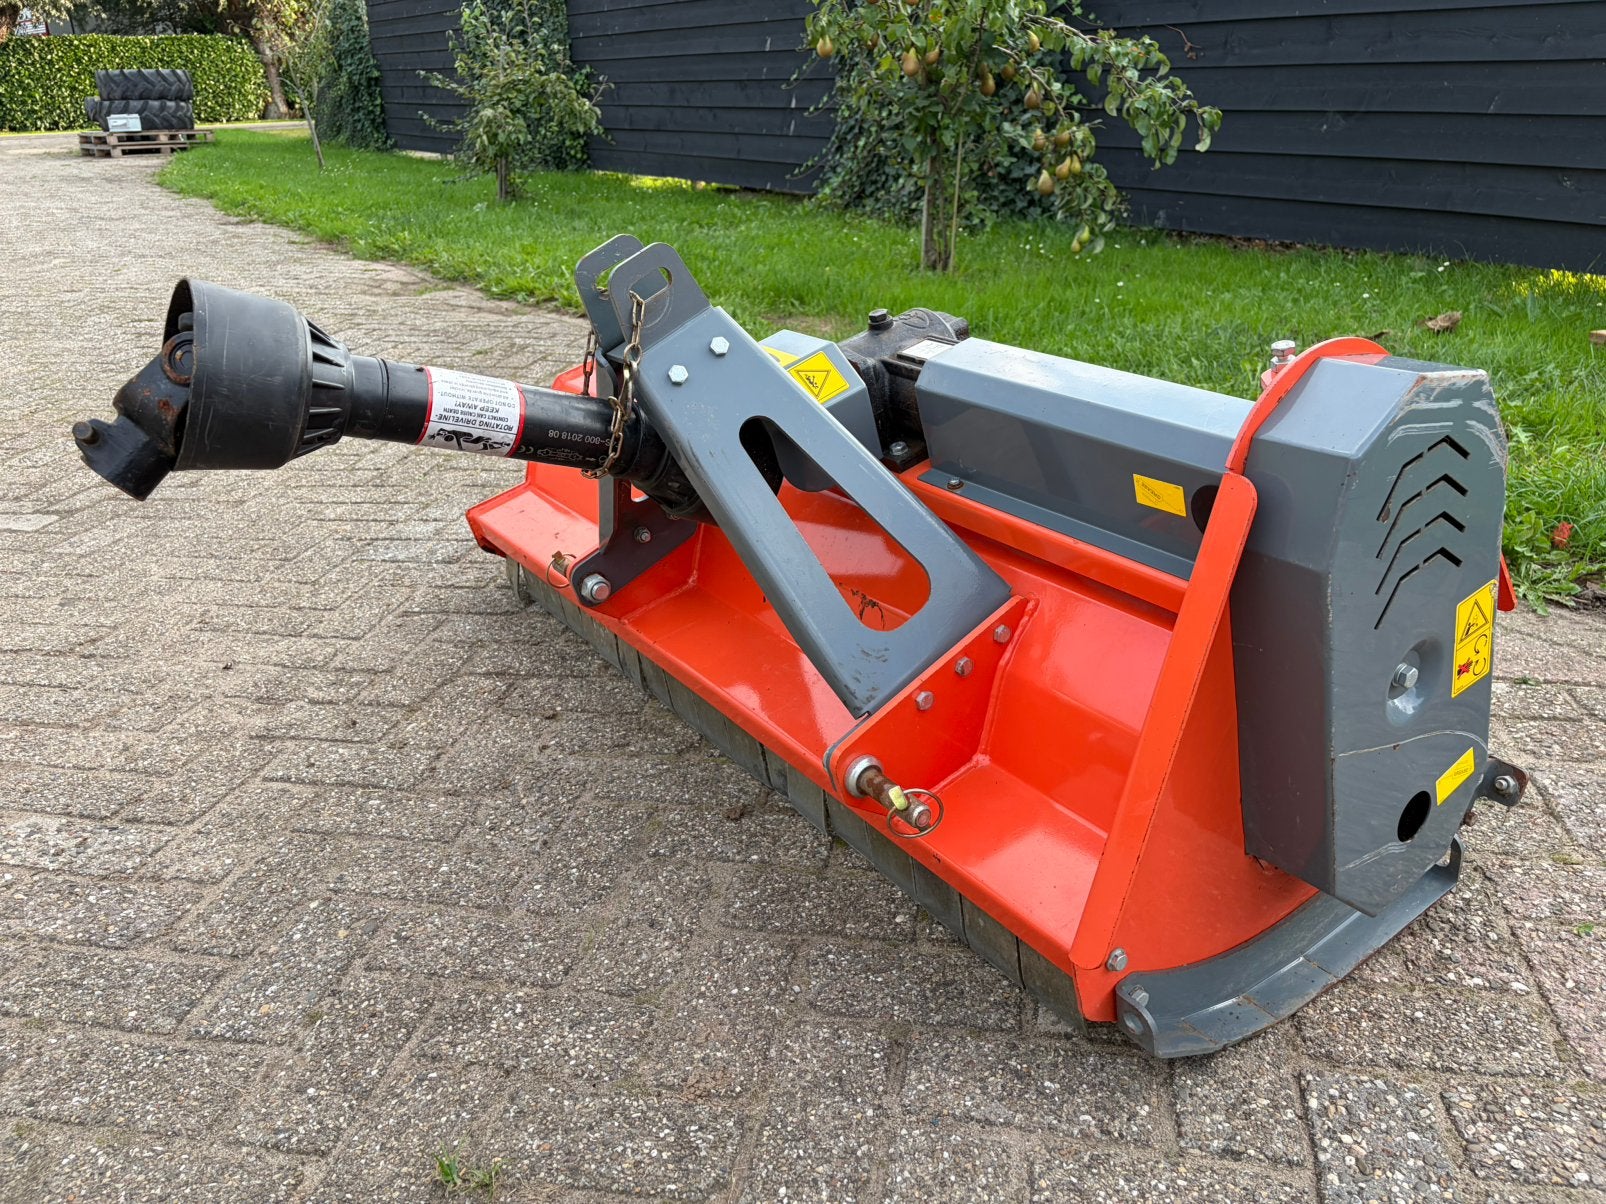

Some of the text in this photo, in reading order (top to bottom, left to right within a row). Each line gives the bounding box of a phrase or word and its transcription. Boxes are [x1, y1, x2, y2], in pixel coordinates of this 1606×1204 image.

[454, 401, 500, 414] KEEP AWAY!
[487, 414, 509, 422] CONTACT
[478, 420, 514, 431] ROTATING
[548, 429, 560, 438] 08
[561, 431, 583, 442] 2018
